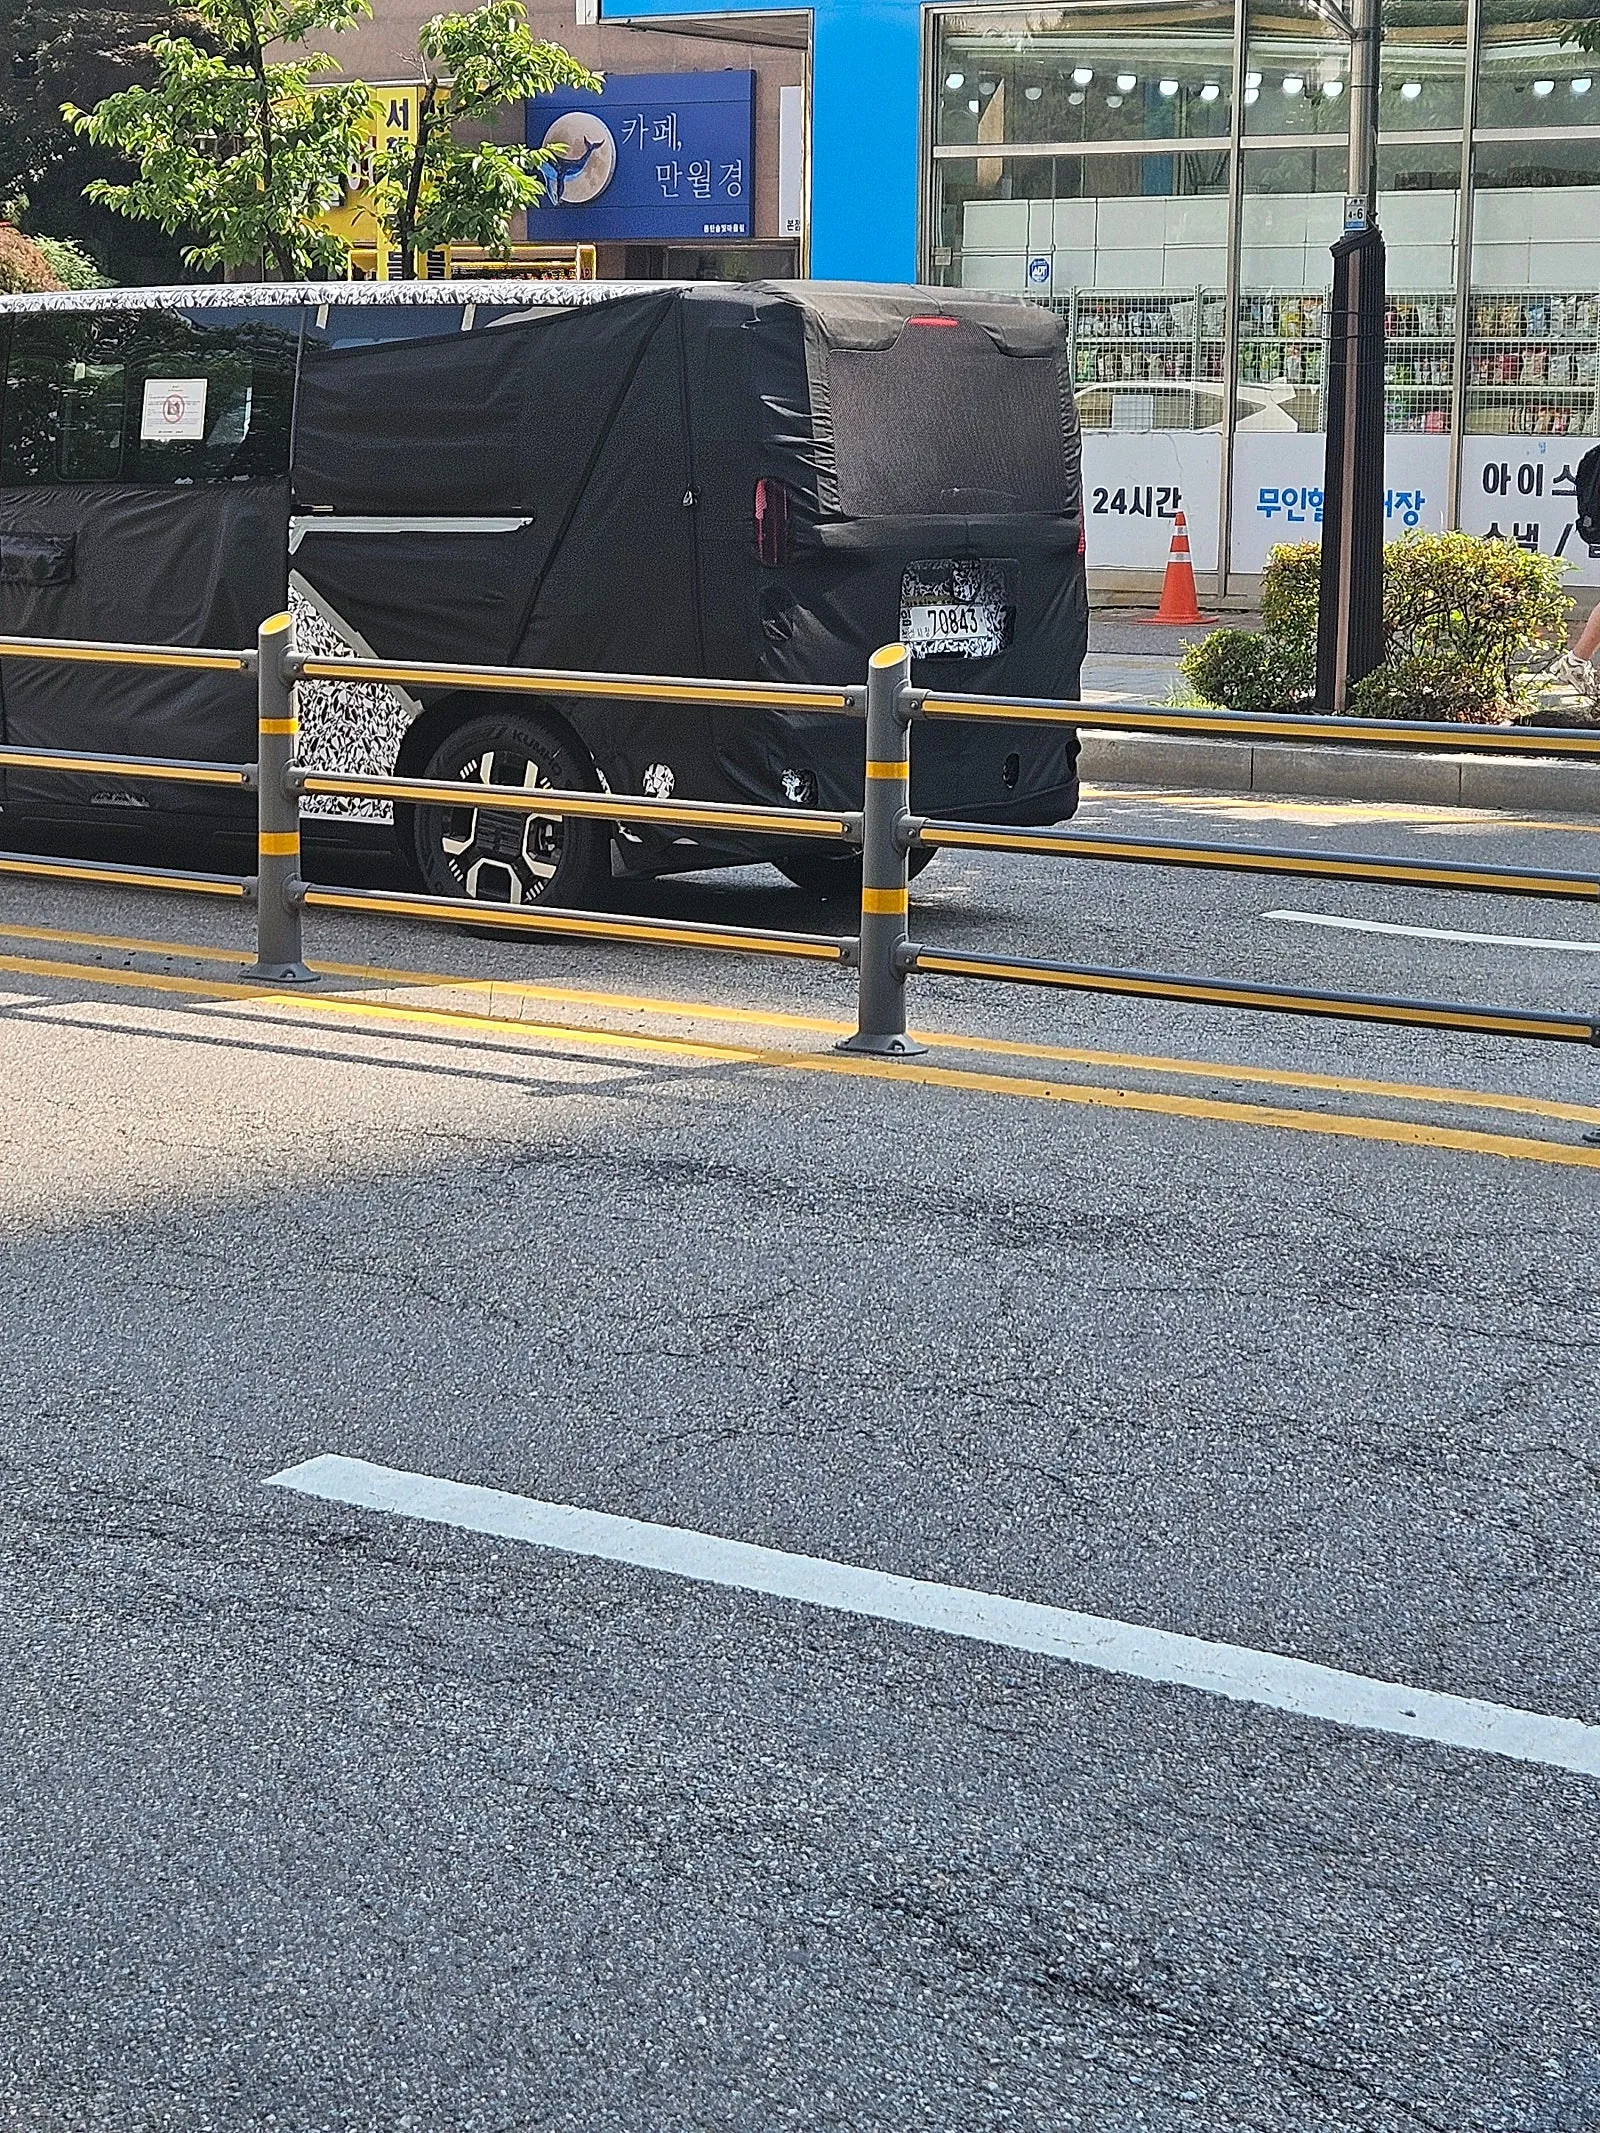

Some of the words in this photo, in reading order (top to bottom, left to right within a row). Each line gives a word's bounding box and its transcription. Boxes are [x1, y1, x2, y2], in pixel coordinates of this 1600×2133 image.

[621, 112, 682, 152] 카페,
[655, 159, 743, 199] 만월경
[1092, 486, 1182, 519] 24시간
[928, 609, 978, 635] 70843
